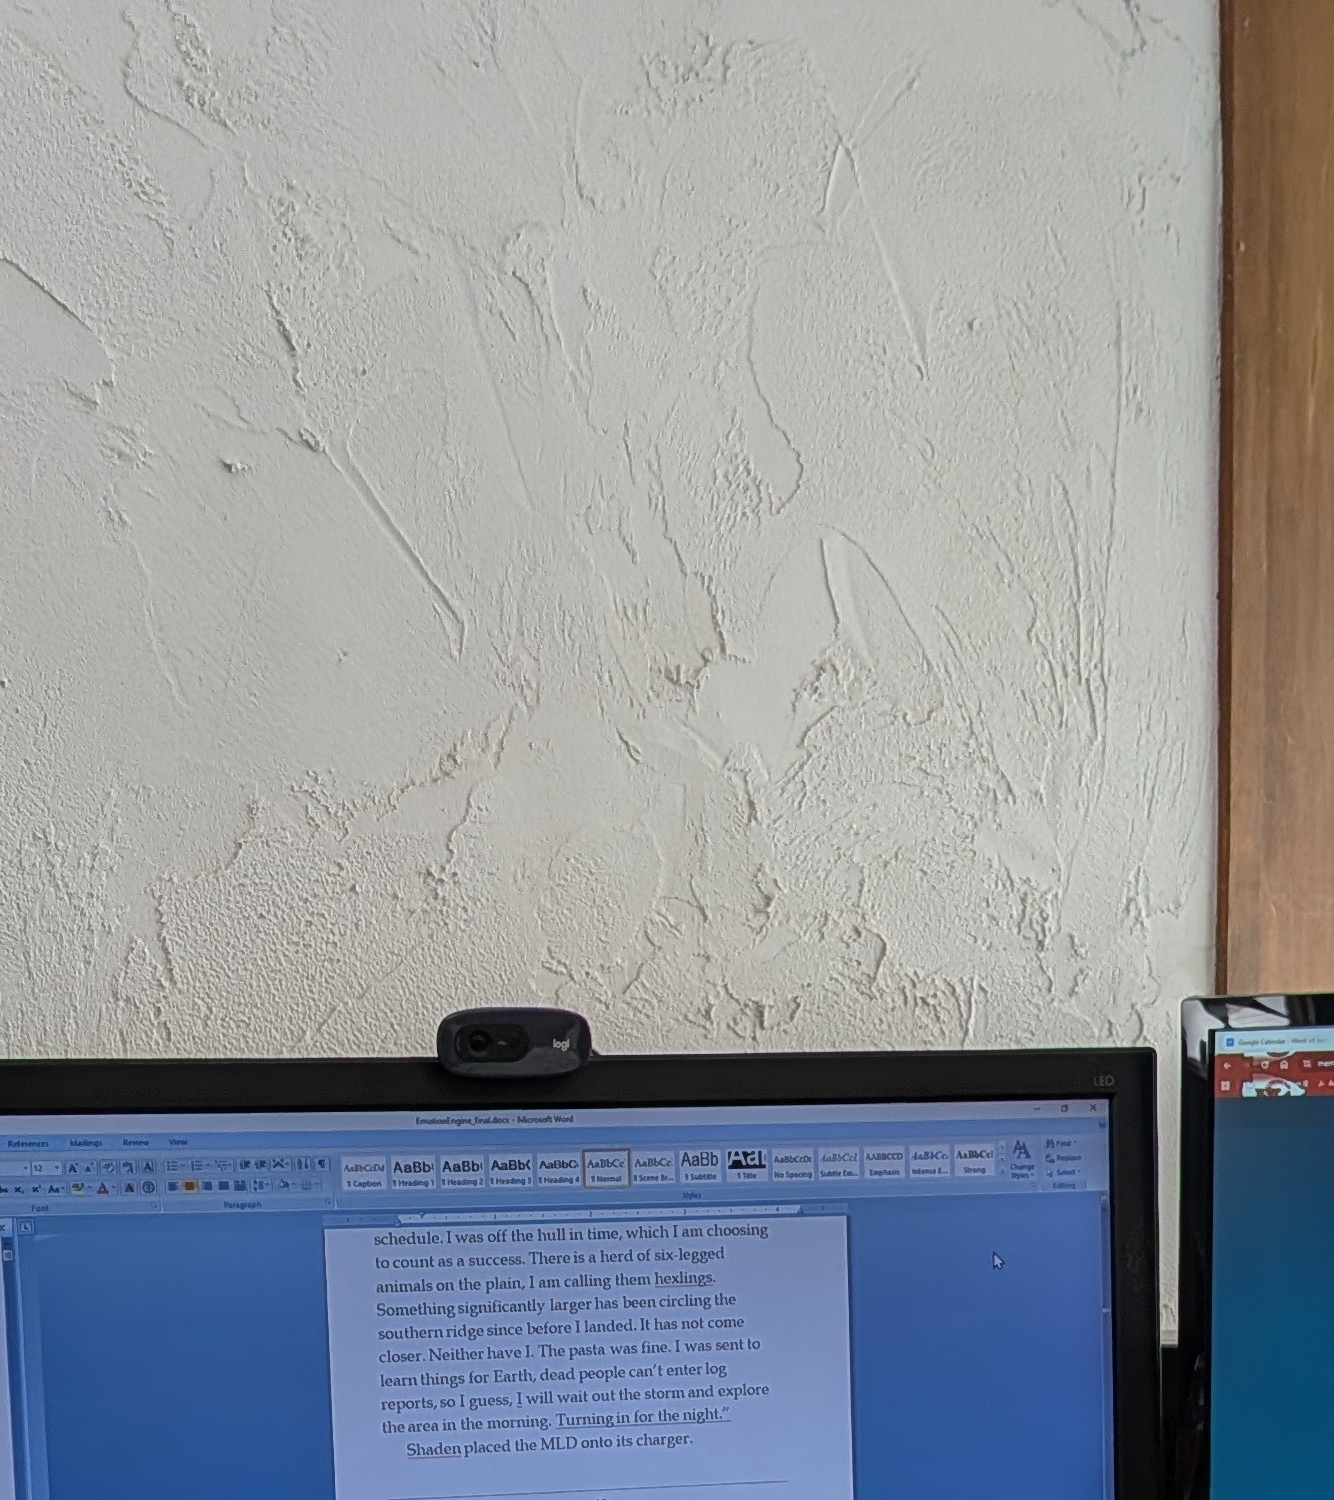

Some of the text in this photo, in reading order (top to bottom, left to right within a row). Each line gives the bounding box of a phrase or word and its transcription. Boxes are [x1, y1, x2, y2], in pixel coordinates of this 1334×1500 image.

[553, 1039, 569, 1051] logi
[376, 1246, 724, 1269] to count as a success. There is a herd of six-legged
[376, 1271, 716, 1295] animals on the plain, I am calling them hexlings.
[407, 1434, 693, 1458] Shaden placed the MLD onto its charger.
